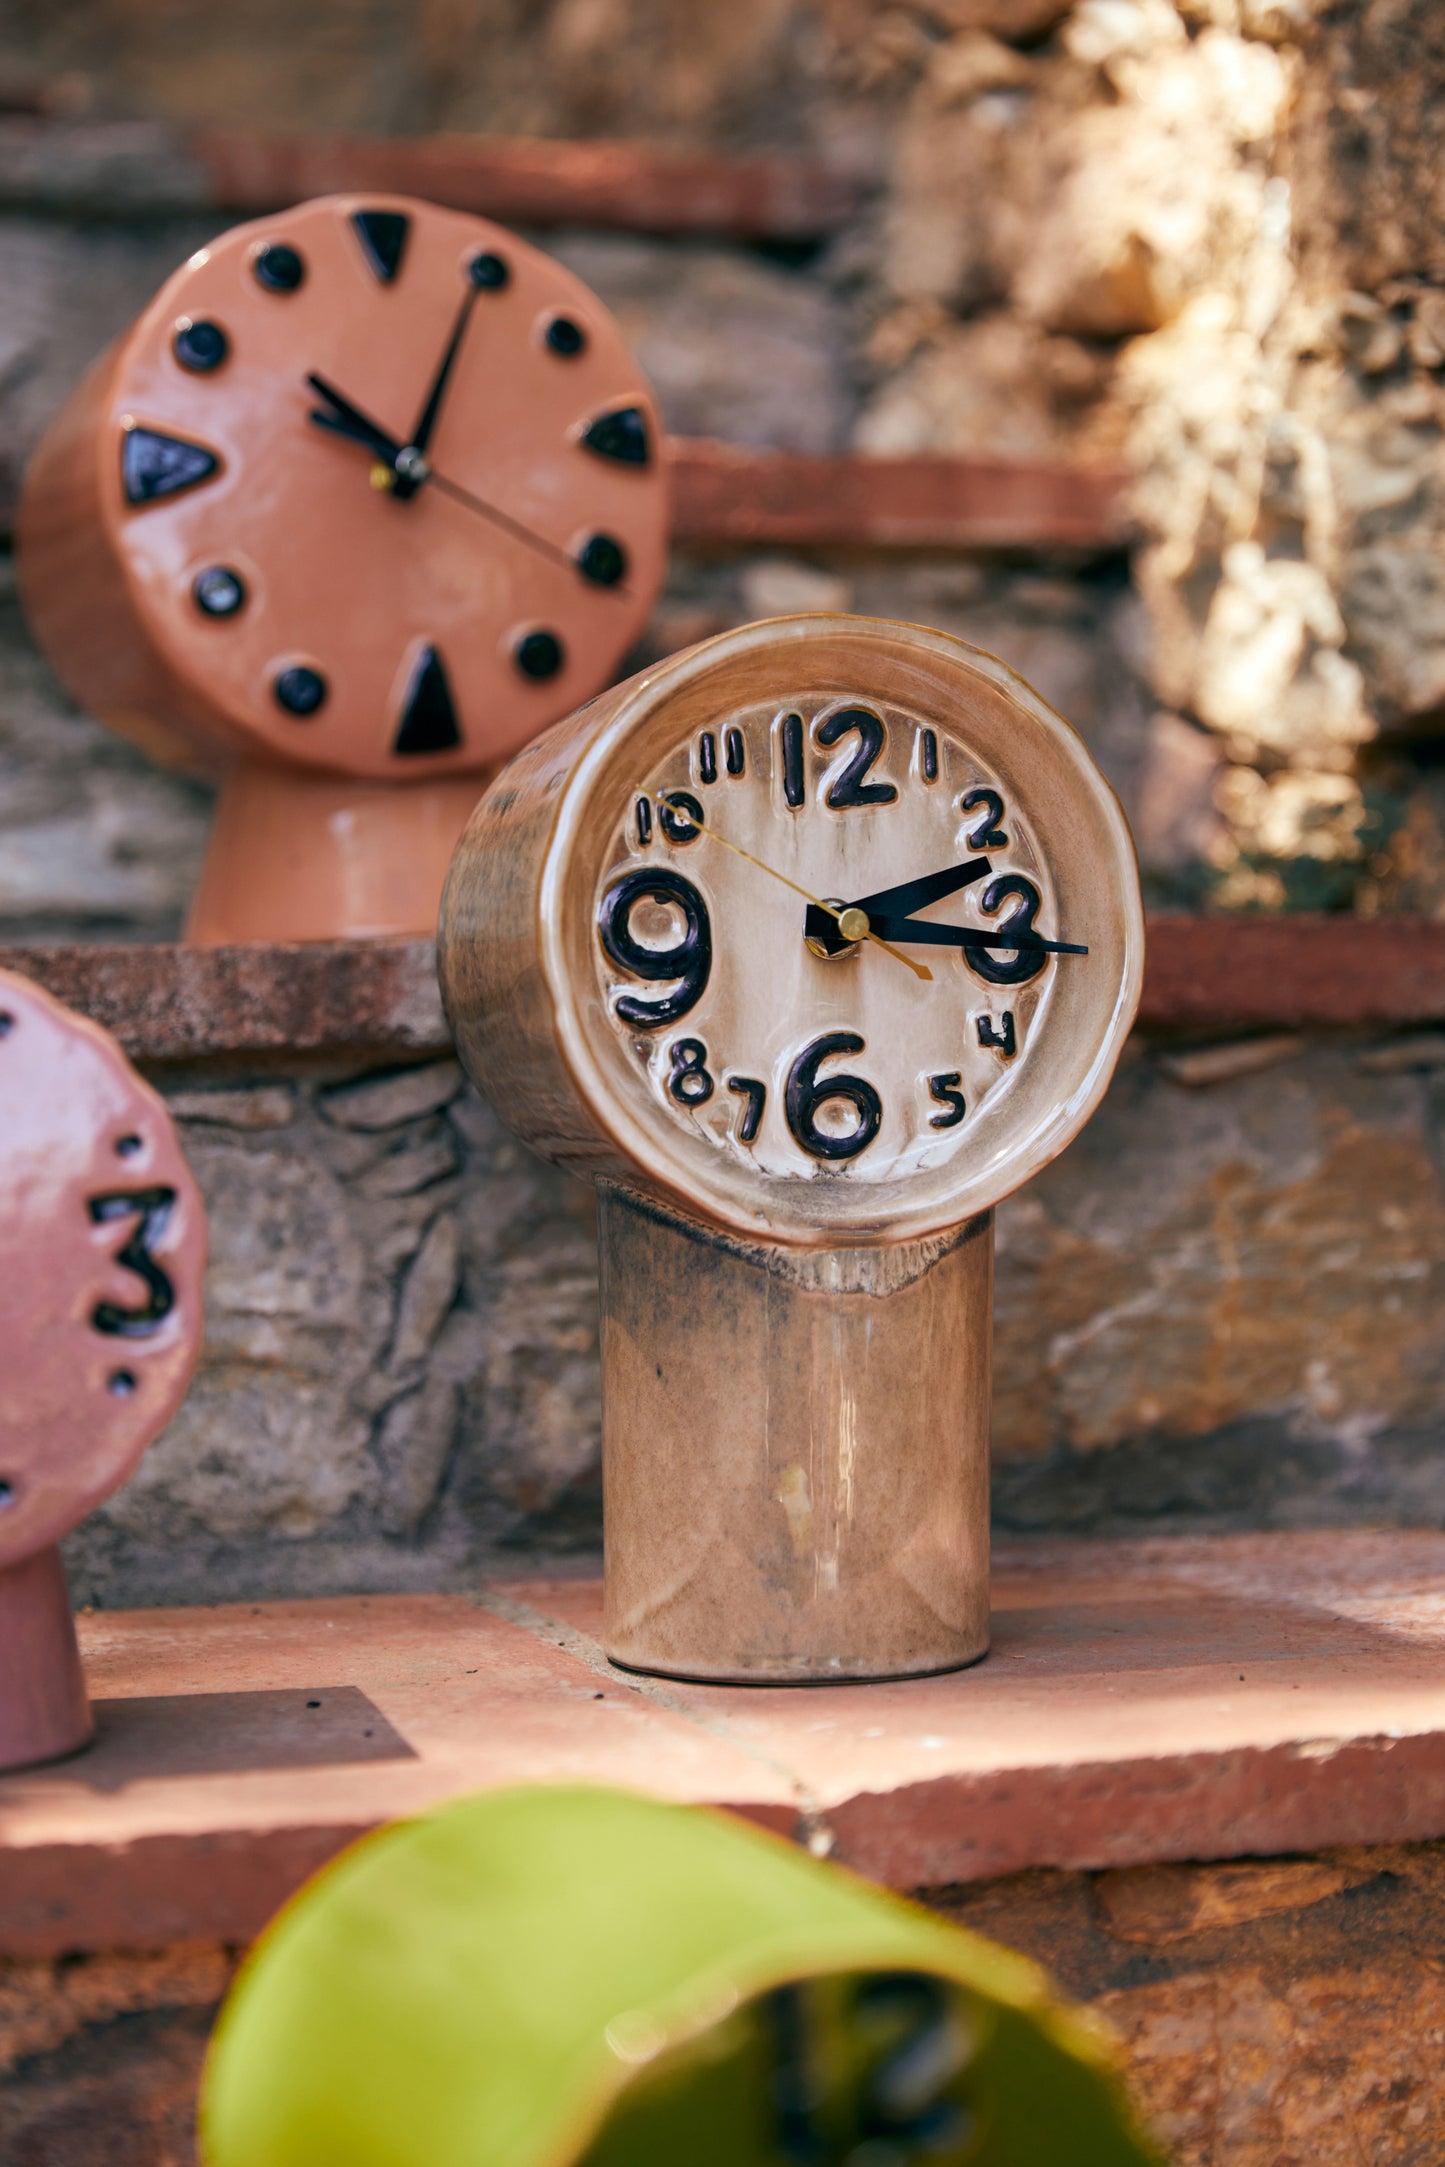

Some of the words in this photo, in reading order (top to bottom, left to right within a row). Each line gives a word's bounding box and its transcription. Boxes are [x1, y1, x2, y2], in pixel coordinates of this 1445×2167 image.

[700, 727, 744, 784] 11
[782, 709, 897, 808] 12
[923, 728, 938, 779] 1
[637, 792, 704, 845] 10
[962, 789, 1008, 850] 2
[600, 868, 712, 1028] 9
[964, 874, 1047, 985] 3
[978, 1011, 1016, 1059] 4
[669, 1038, 713, 1104] 8
[785, 1032, 881, 1159] 6
[930, 1073, 966, 1127] 5
[729, 1077, 765, 1141] 7
[88, 1186, 176, 1337] 3
